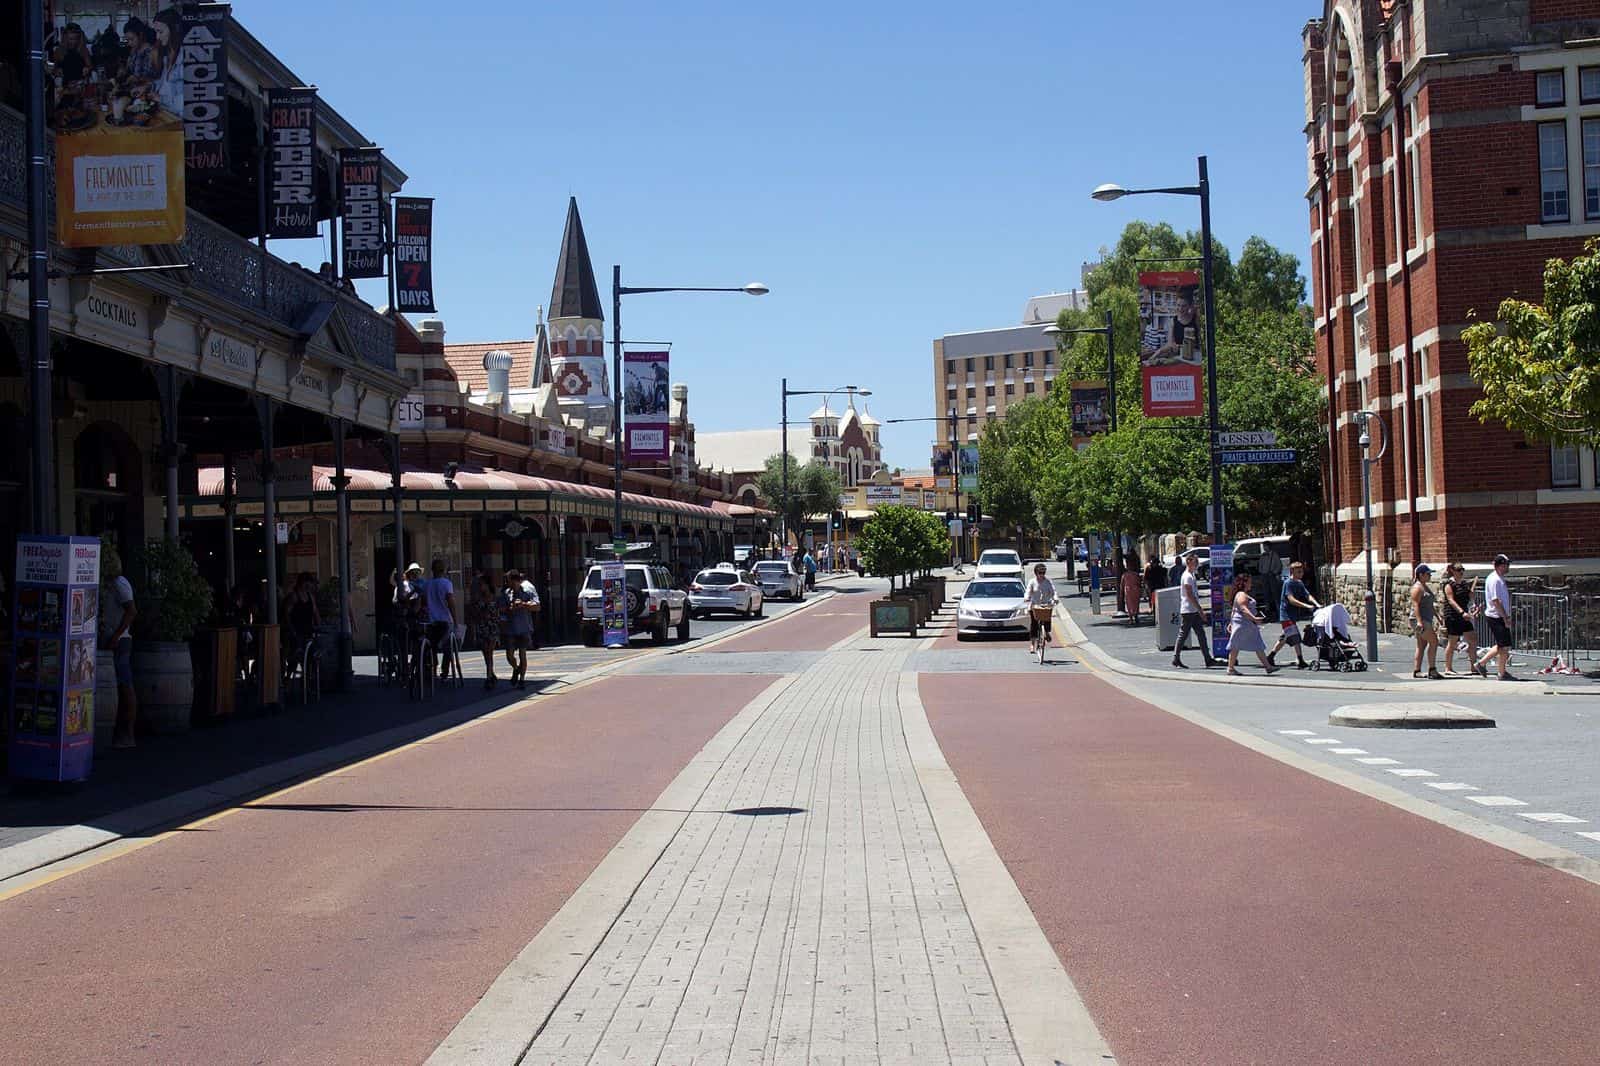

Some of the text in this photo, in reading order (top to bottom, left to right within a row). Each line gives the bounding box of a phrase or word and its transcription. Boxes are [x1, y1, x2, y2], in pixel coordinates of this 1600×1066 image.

[183, 26, 224, 141] ANCHOR
[272, 108, 312, 127] CRAFT
[273, 128, 316, 204] BEER
[344, 165, 378, 183] ENJOY
[86, 163, 156, 190] FREMANTLE
[275, 205, 312, 226] Here!
[345, 185, 383, 250] BEER
[398, 235, 428, 245] BALCONY
[398, 246, 428, 262] OPEN
[402, 263, 422, 288] 7
[399, 290, 430, 306] DAYS
[88, 296, 137, 327] COCKTAILS
[1229, 433, 1264, 443] ESSEX
[1222, 452, 1289, 462] PIRATES BACKPACKERS
